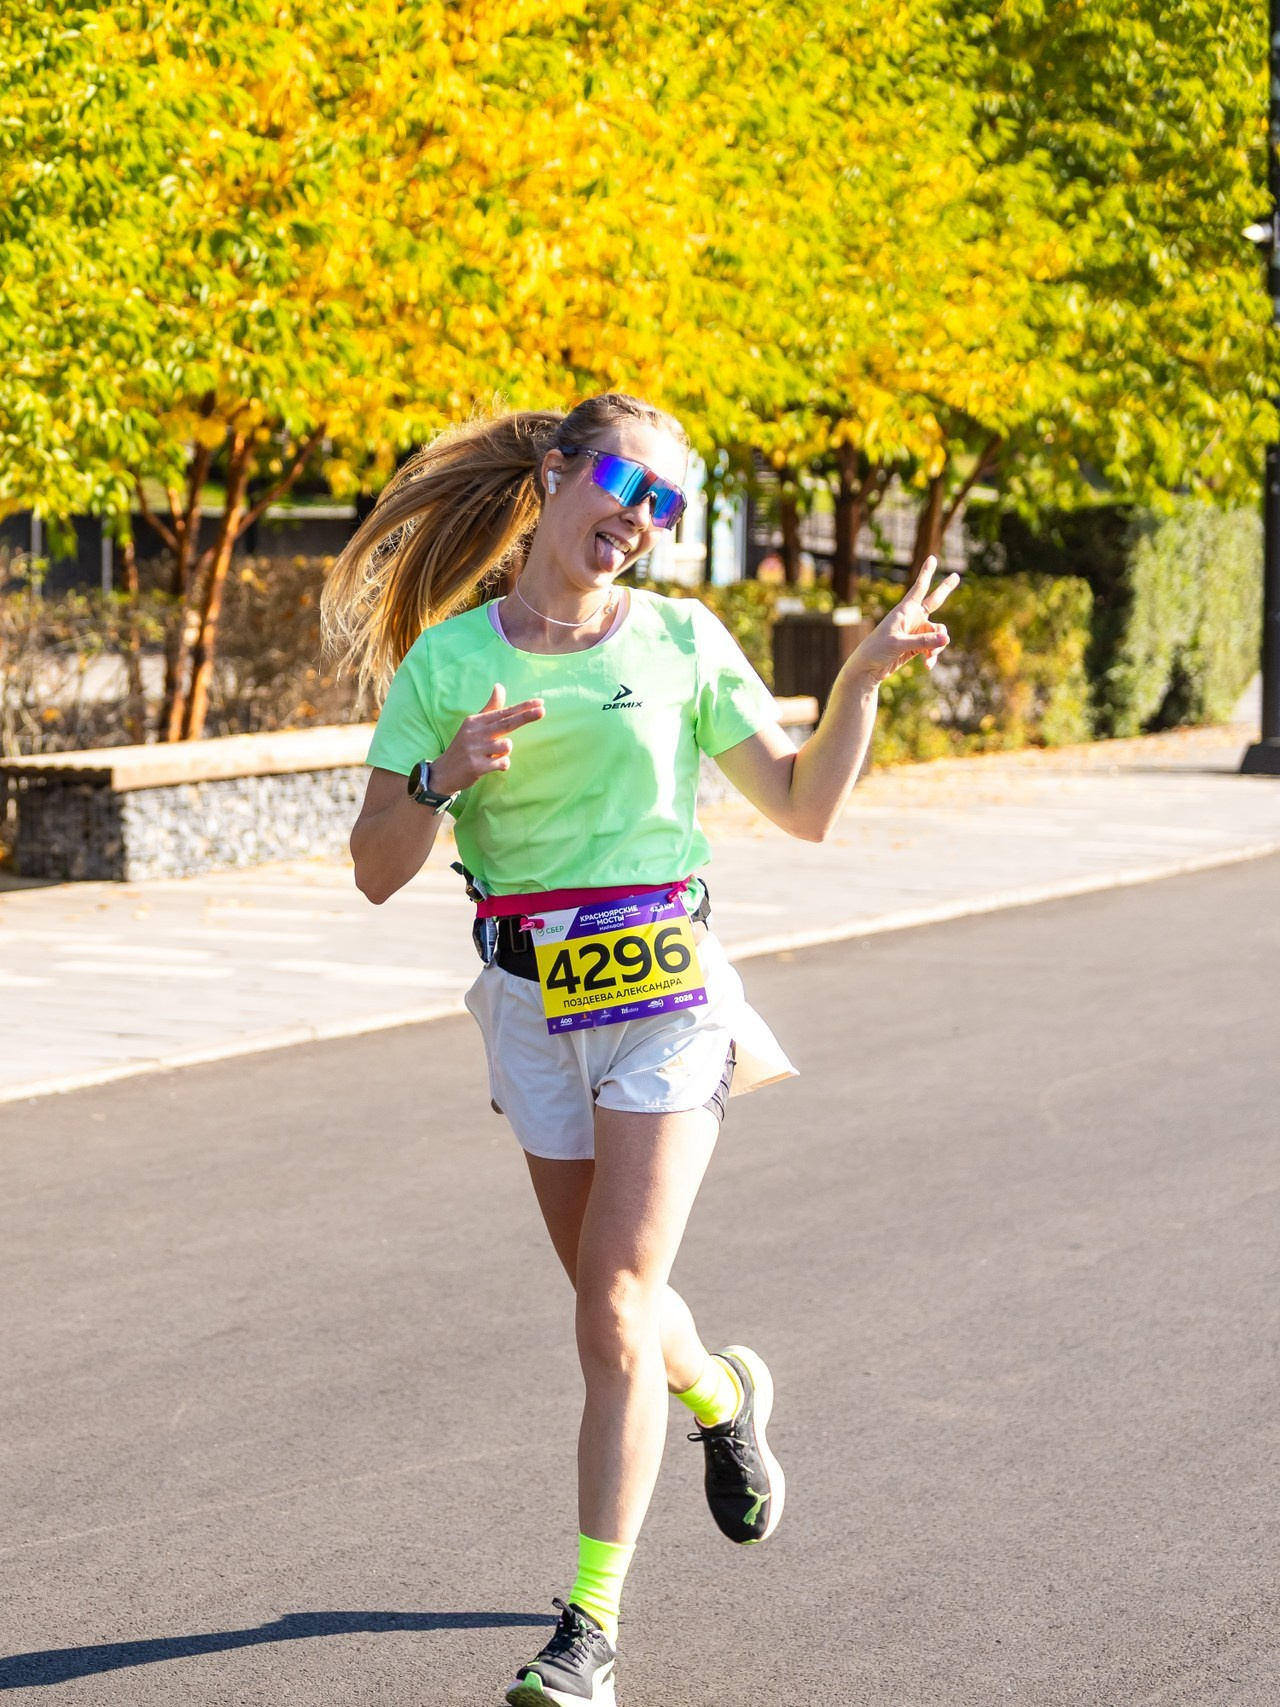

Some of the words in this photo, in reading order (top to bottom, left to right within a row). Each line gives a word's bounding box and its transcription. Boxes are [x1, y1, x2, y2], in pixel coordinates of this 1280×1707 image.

[602, 701, 643, 711] DEMIX
[580, 904, 639, 922] КРАСНОЯРСКИЕ
[596, 914, 625, 926] МОСТЫ
[545, 925, 564, 935] СБЕР
[546, 926, 691, 995] 4296
[563, 993, 614, 1008] ПОЗДЕЕВА
[615, 977, 683, 998] АЛЕКСАНДРА
